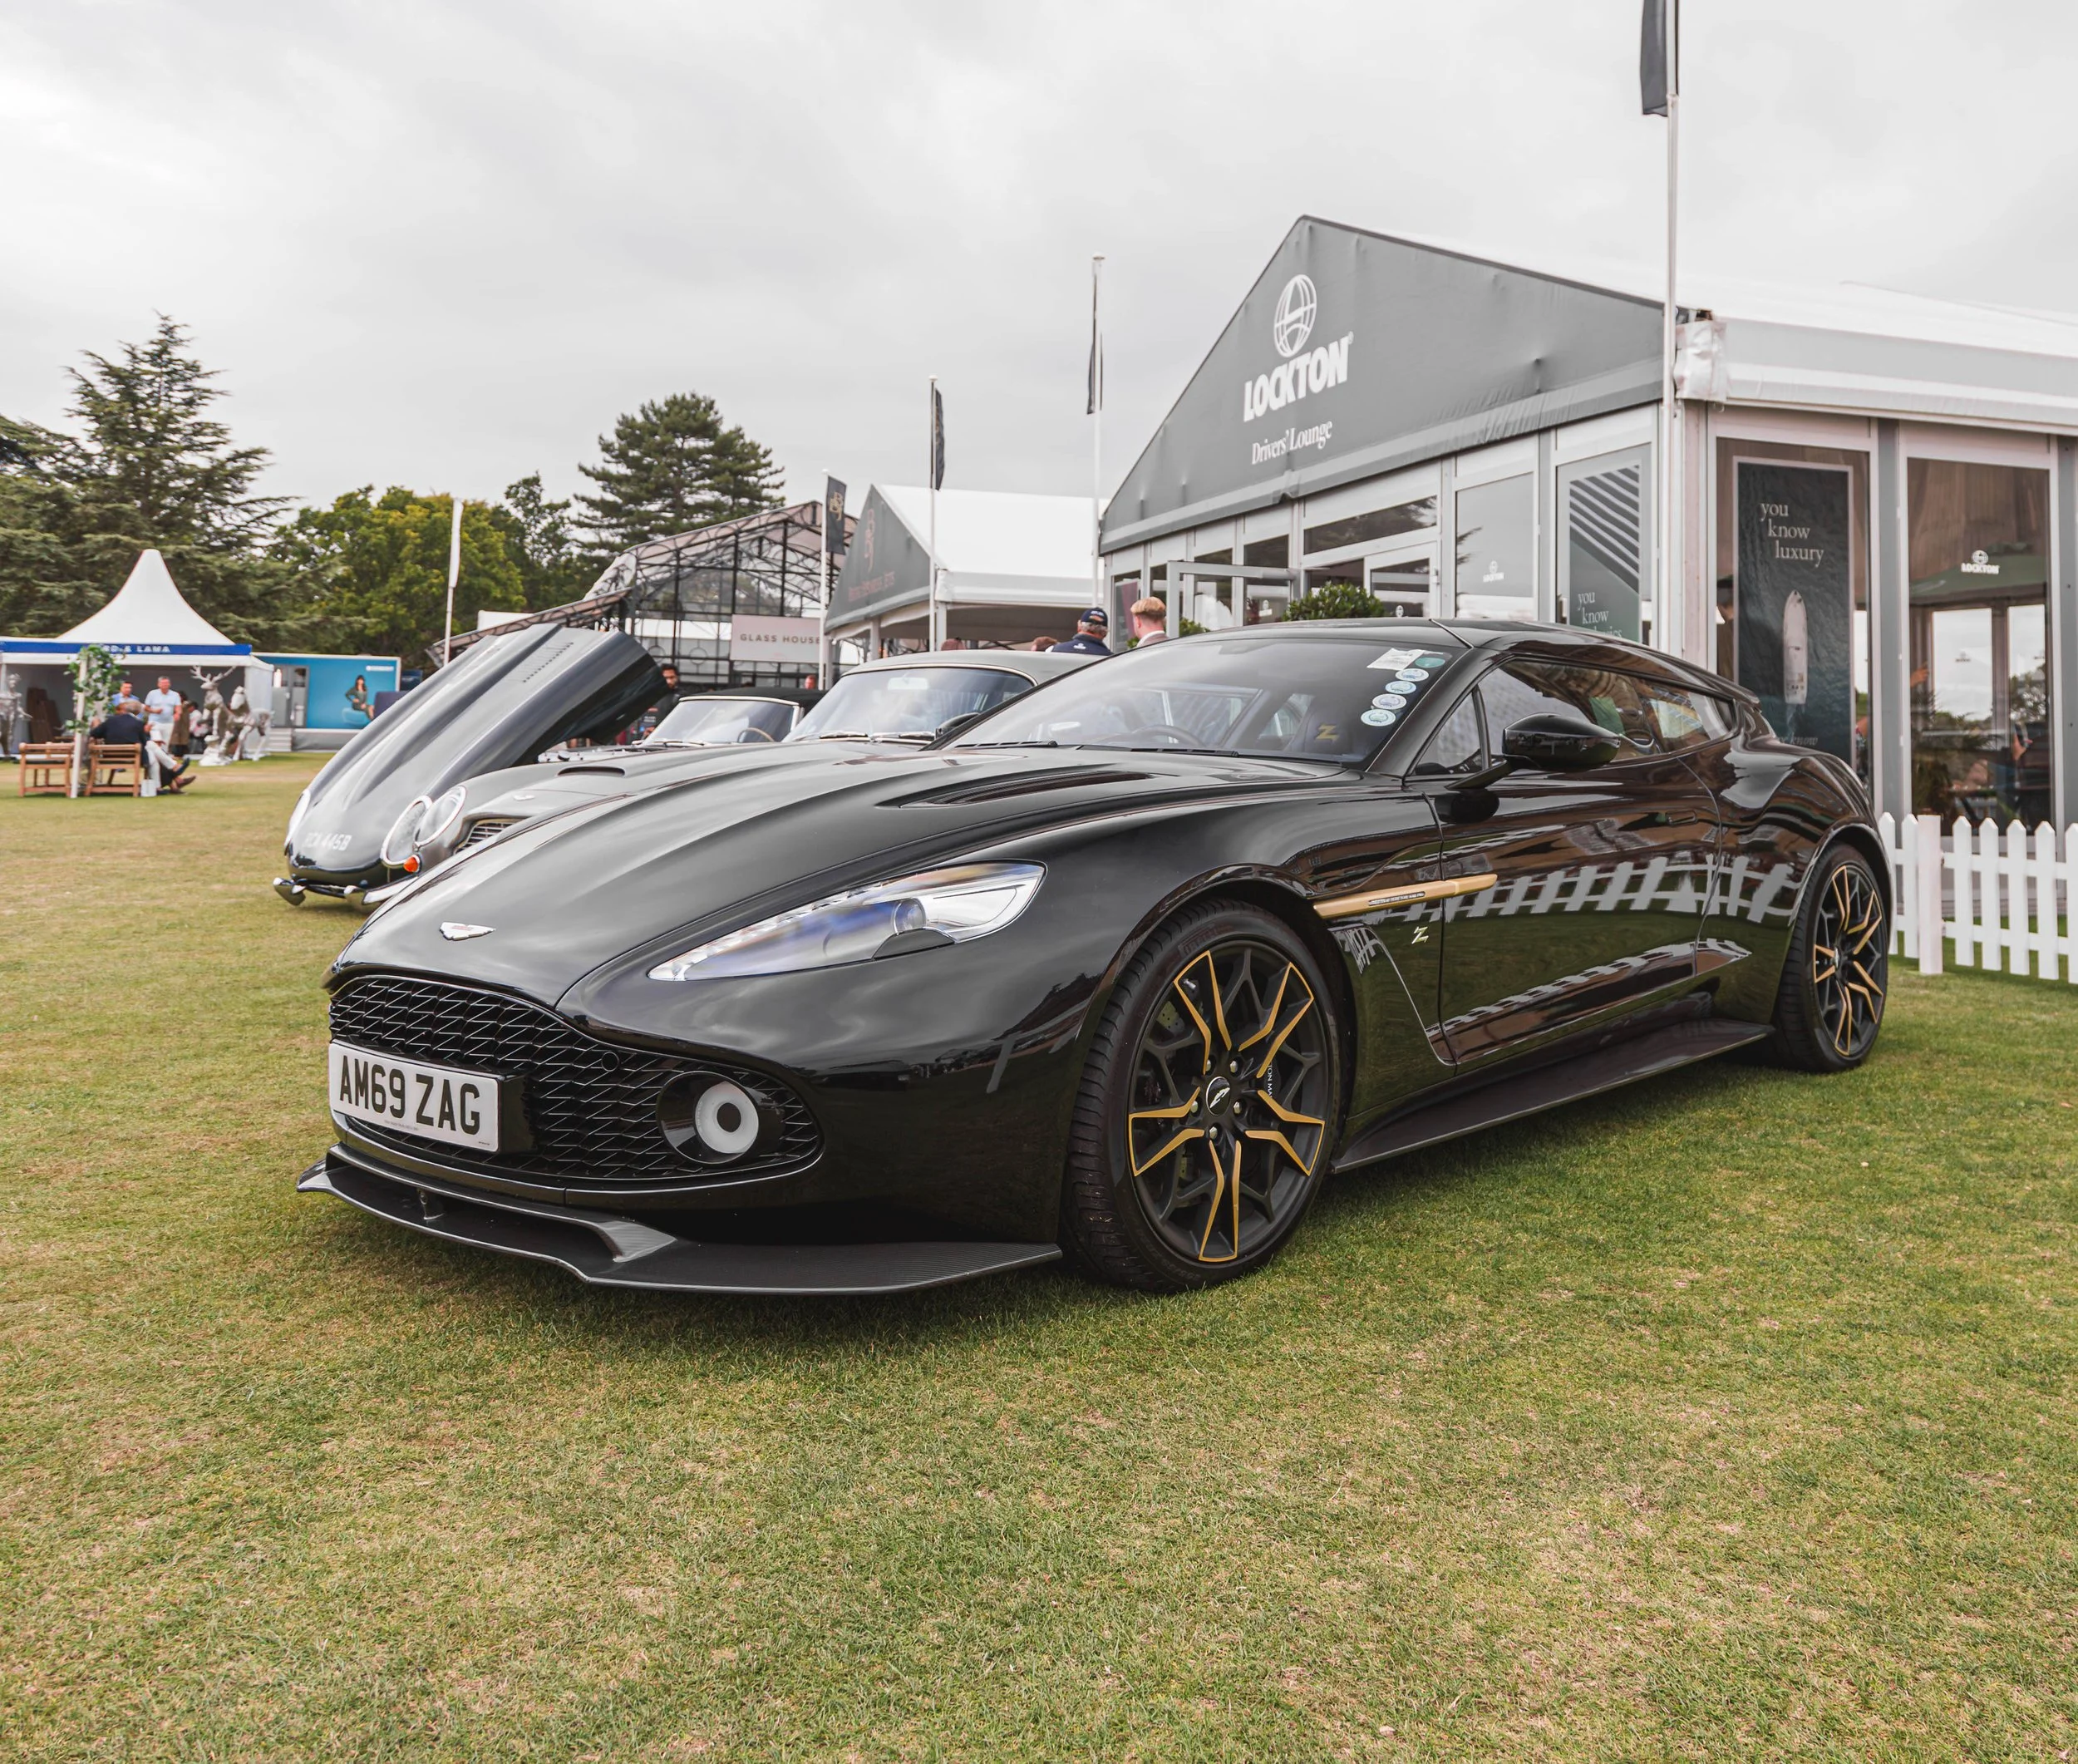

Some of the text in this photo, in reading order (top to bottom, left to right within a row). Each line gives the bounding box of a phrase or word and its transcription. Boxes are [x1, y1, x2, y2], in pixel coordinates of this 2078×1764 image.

[1243, 336, 1349, 422] LOCKTON
[1289, 421, 1332, 450] Lounge
[1760, 503, 1789, 522] you
[1768, 518, 1811, 539] know
[1775, 540, 1824, 568] luxury
[1578, 592, 1596, 611] you
[1582, 607, 1609, 624] know
[740, 633, 820, 644] GLASS HOUSE
[340, 1055, 480, 1136] AM69 ZAG
